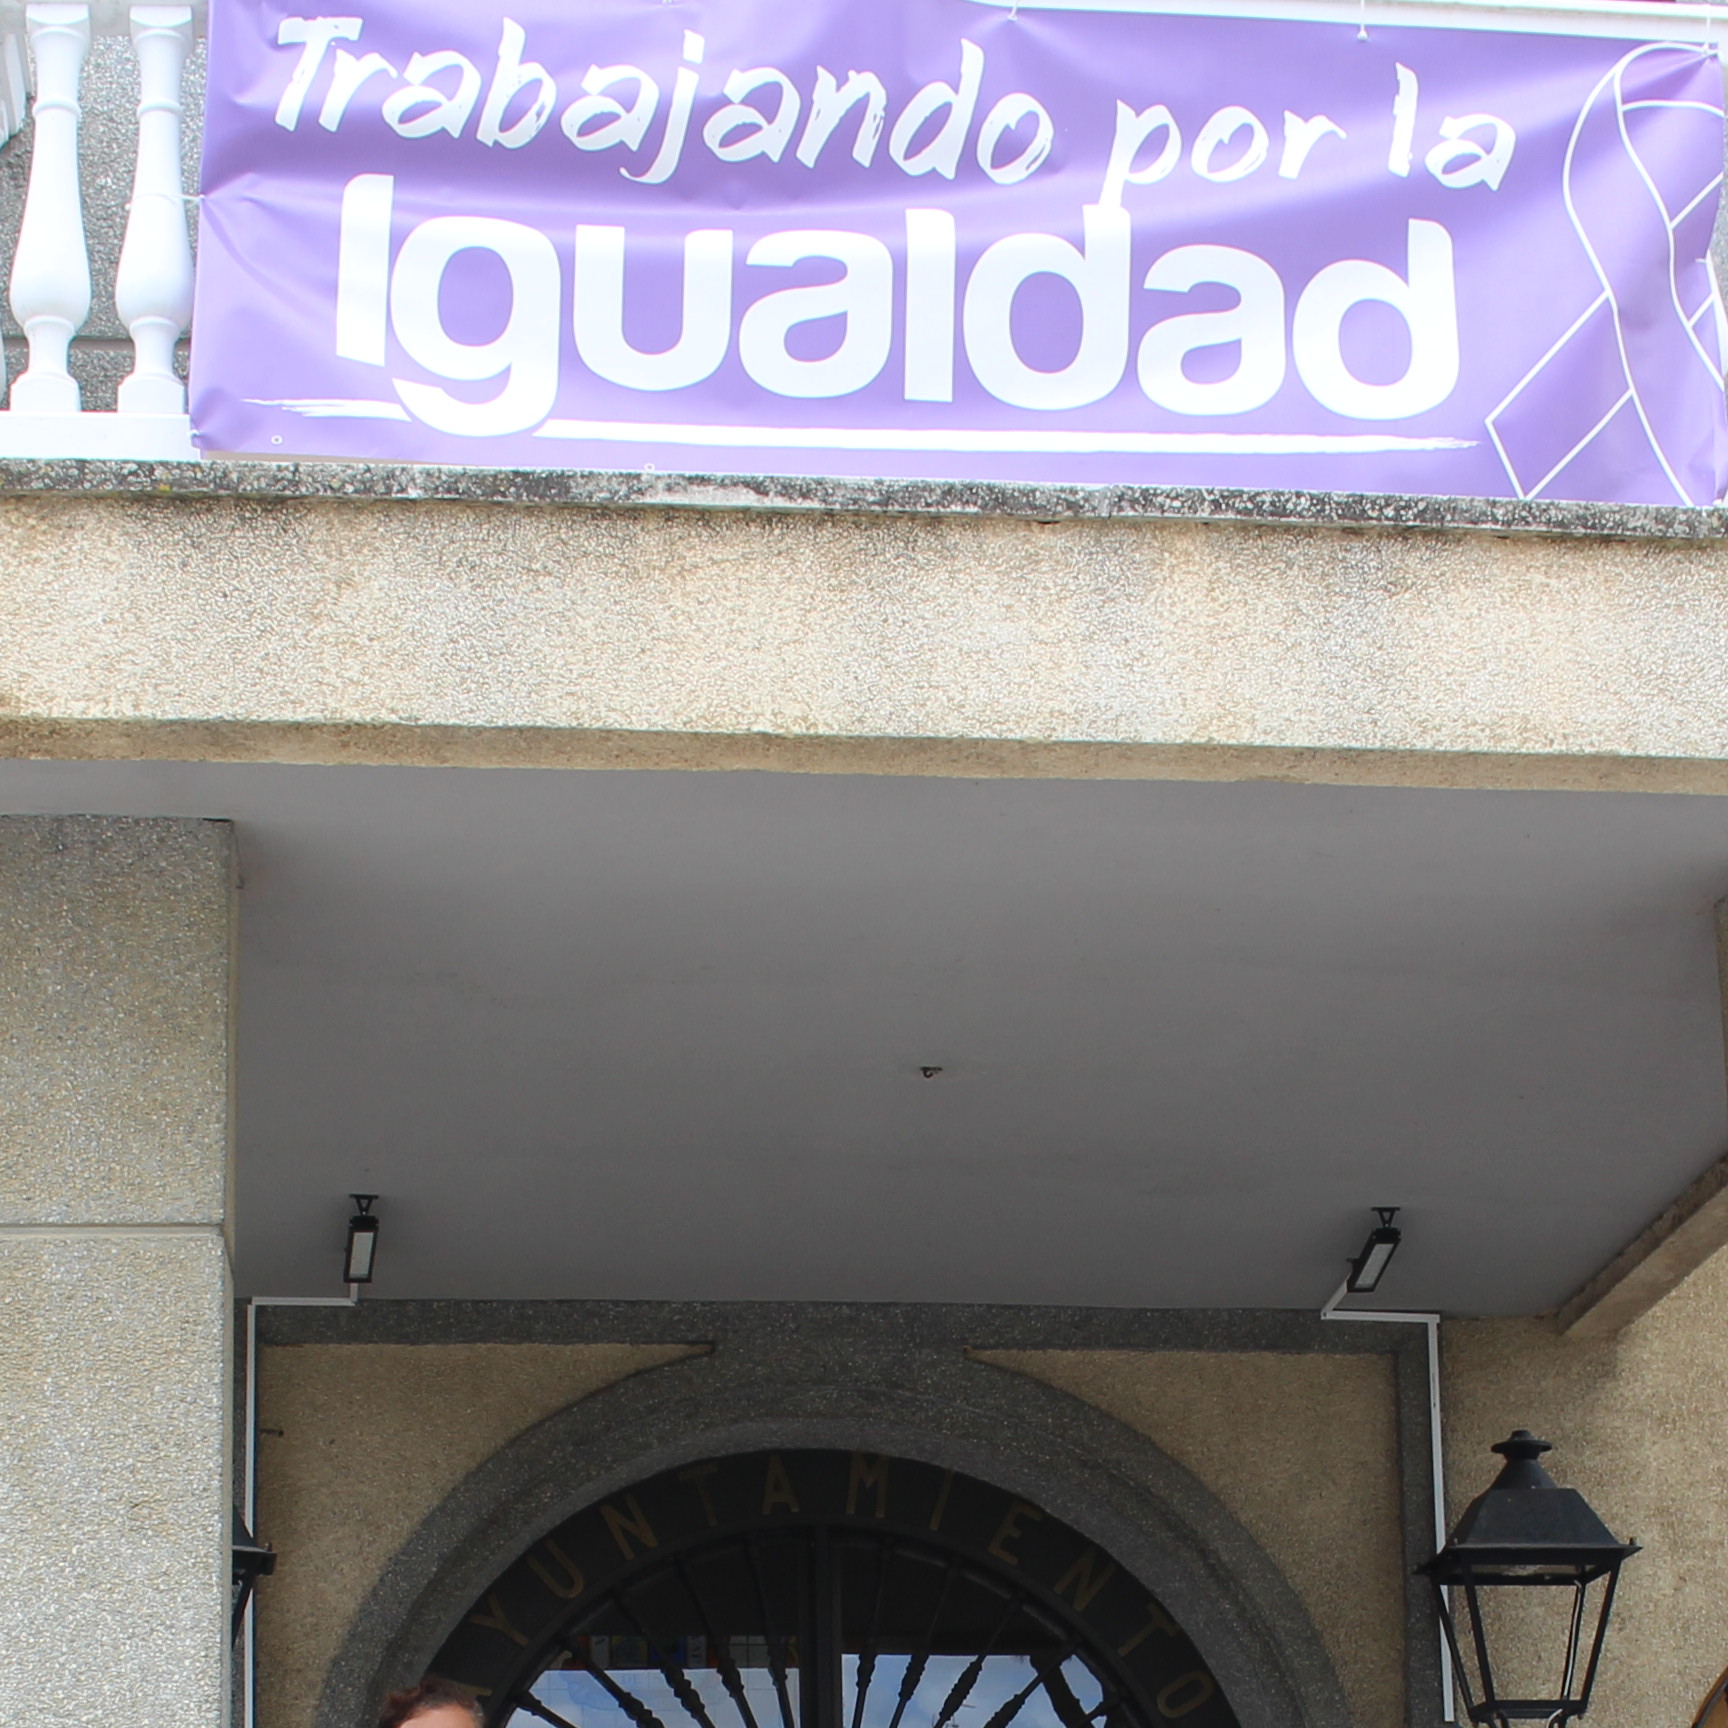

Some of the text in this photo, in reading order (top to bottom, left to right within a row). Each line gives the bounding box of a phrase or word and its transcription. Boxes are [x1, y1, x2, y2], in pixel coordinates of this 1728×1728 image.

[274, 16, 1516, 206] Trabajando por la
[337, 173, 1459, 437] Igualdad
